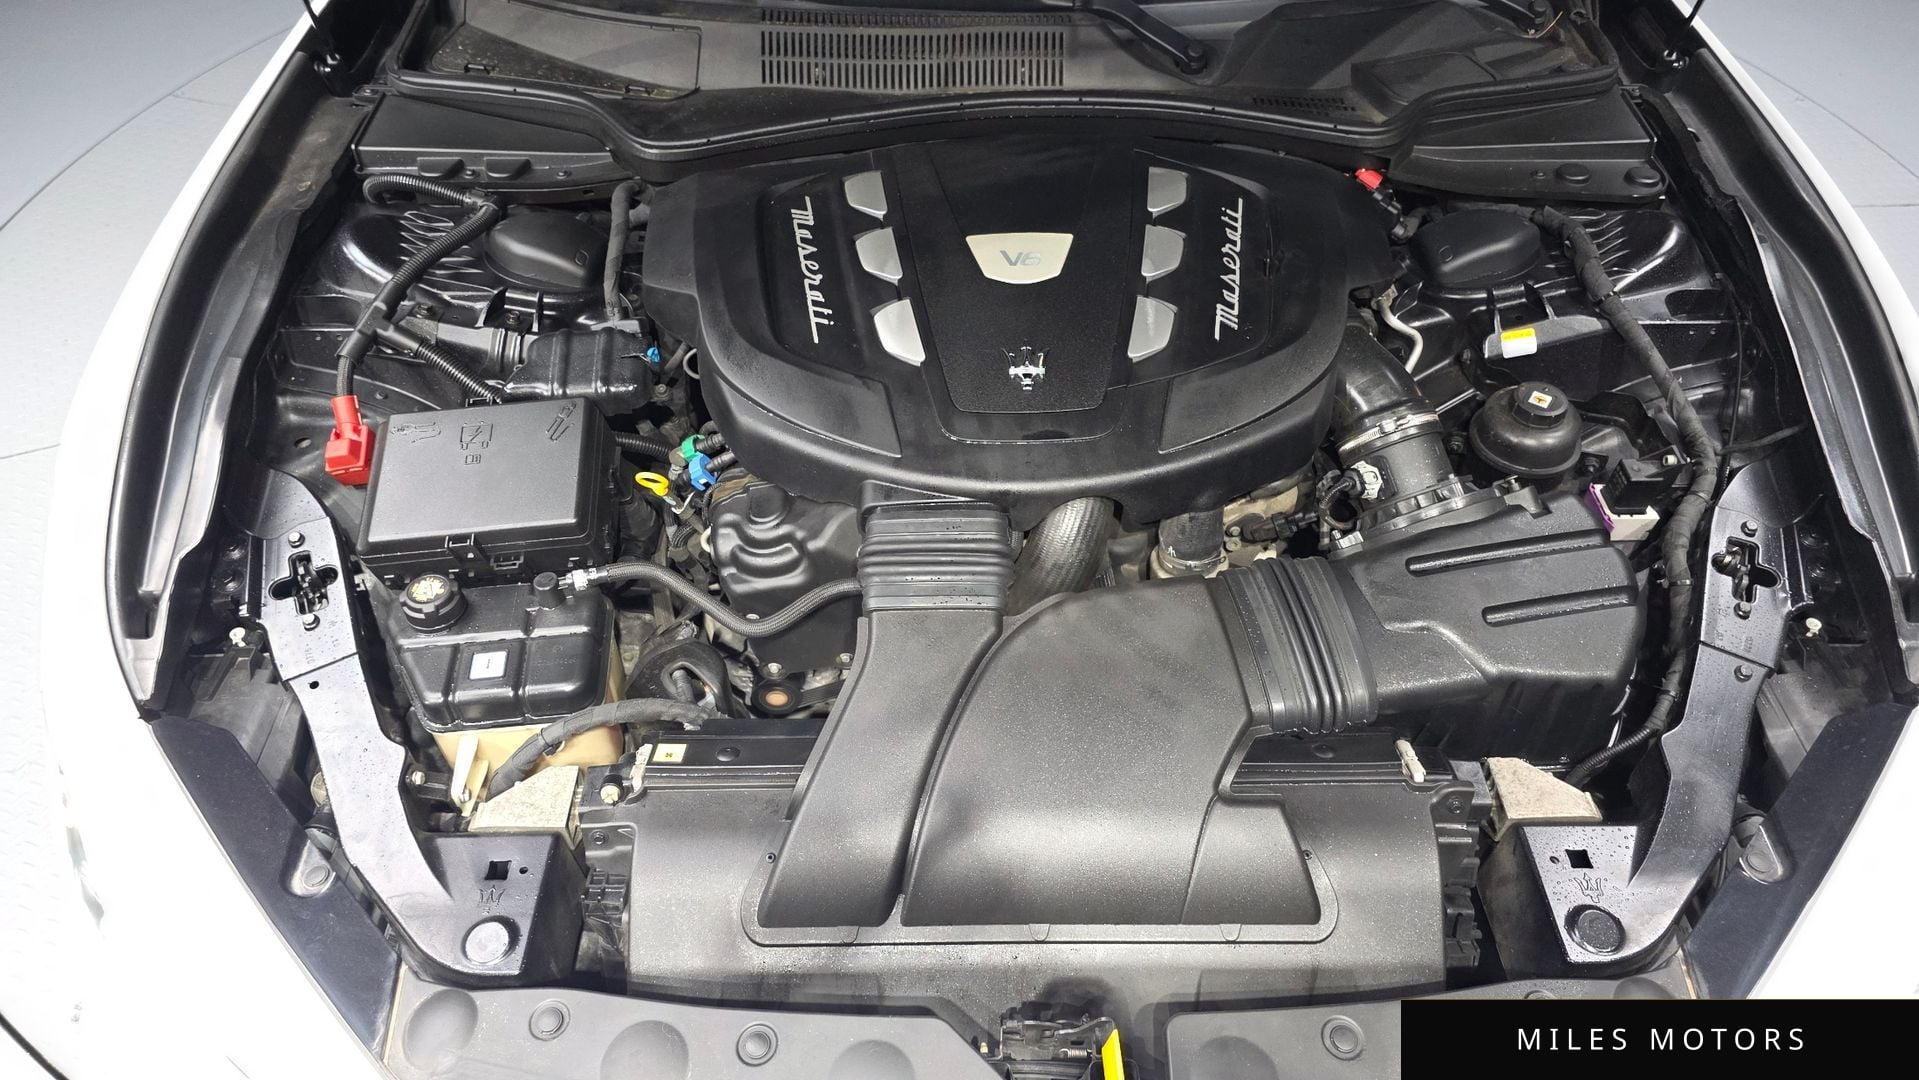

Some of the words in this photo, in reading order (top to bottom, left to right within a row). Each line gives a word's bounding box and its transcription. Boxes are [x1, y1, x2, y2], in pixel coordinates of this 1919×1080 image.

[790, 195, 834, 344] Maserati
[1000, 249, 1041, 267] V6
[1214, 197, 1243, 341] Maserati
